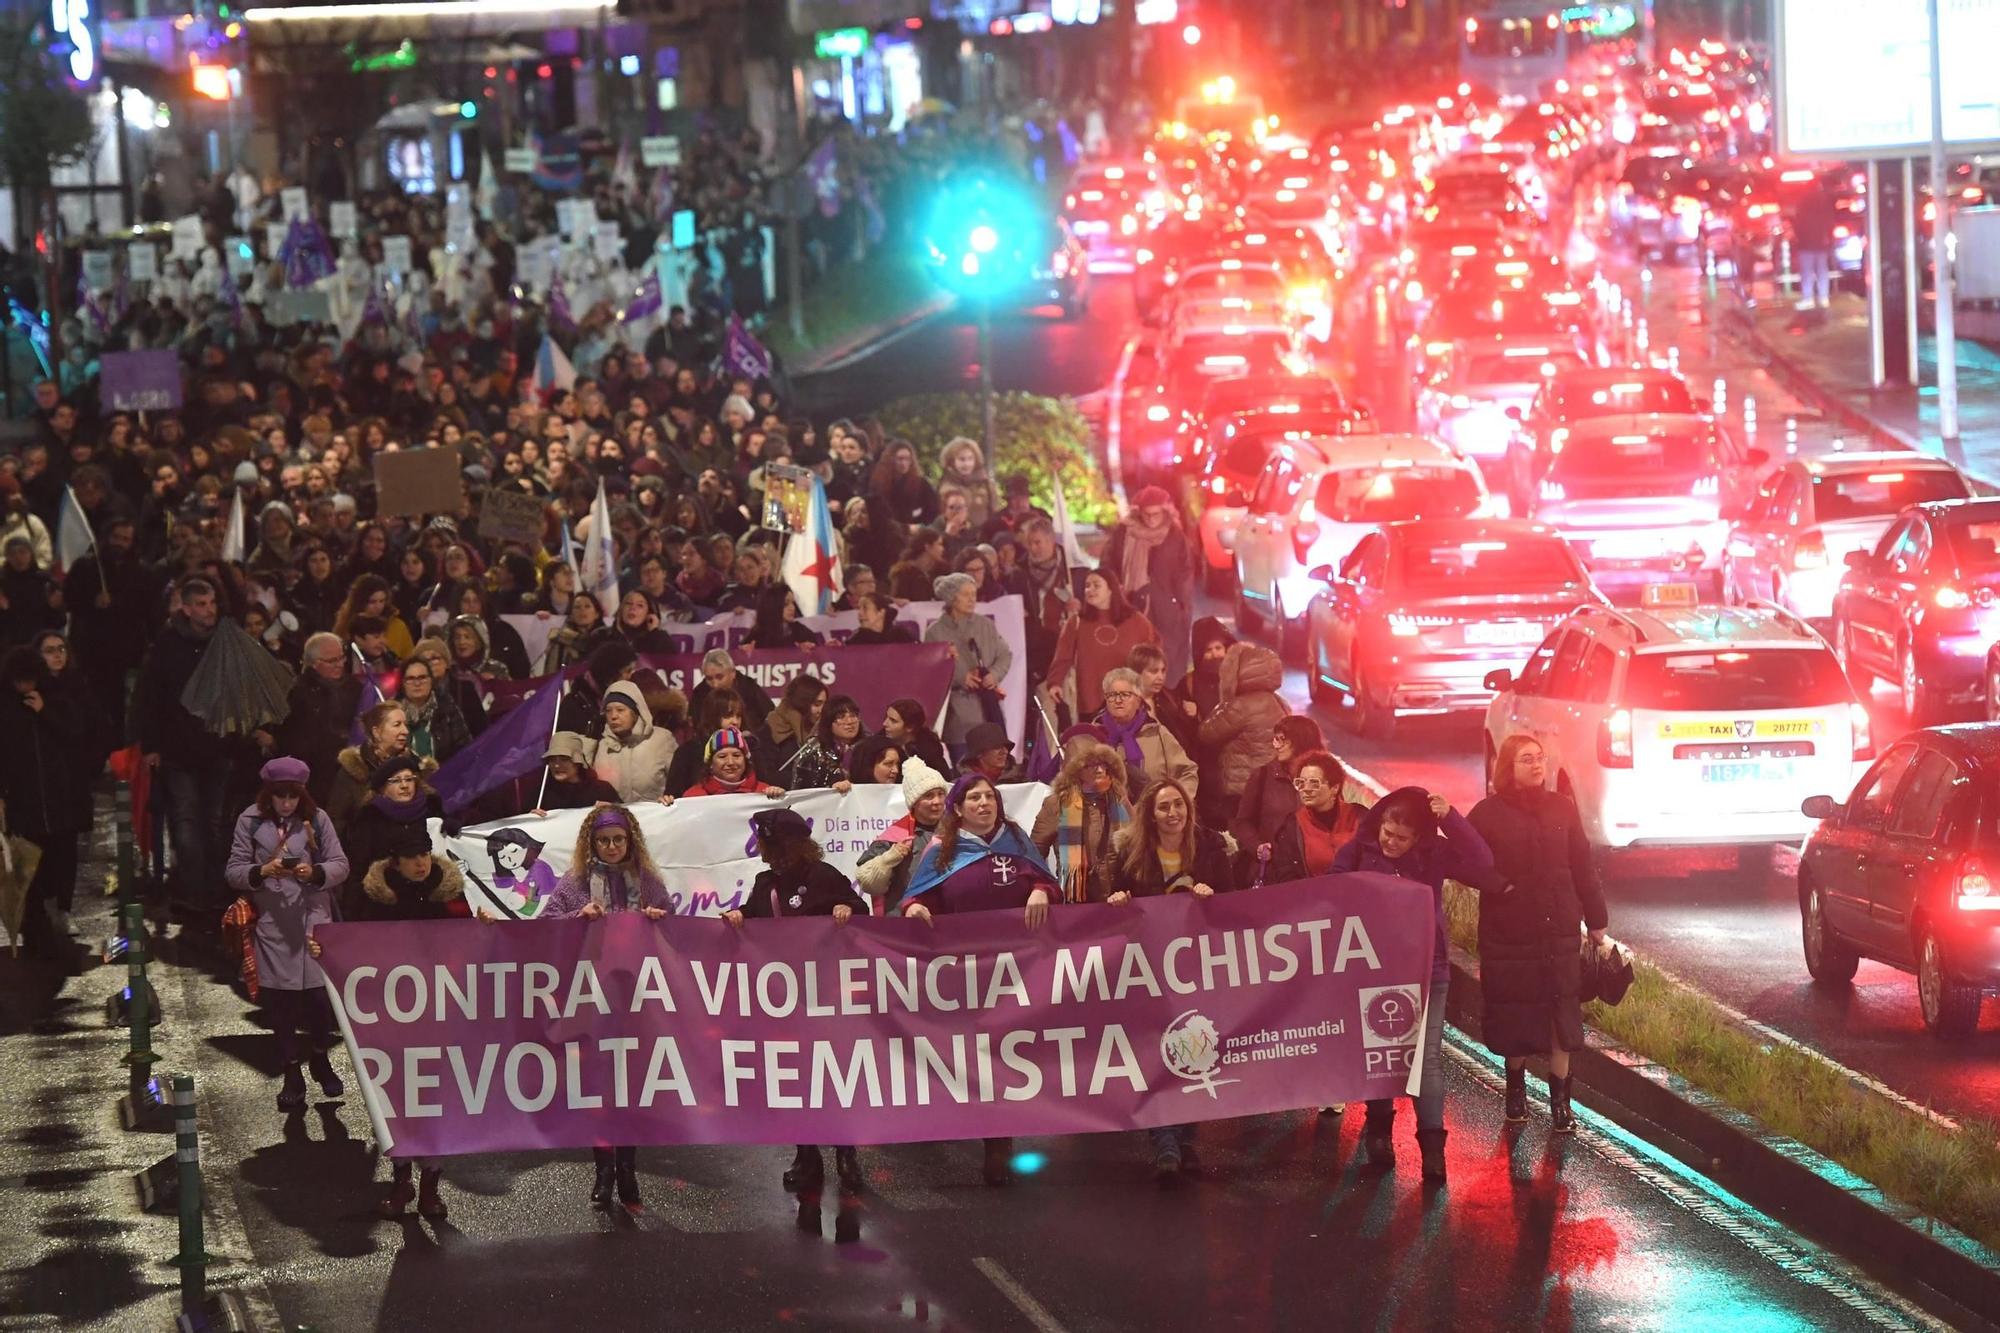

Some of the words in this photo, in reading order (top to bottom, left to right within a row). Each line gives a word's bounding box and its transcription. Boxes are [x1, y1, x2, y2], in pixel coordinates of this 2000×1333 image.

[1709, 726, 1733, 735] TAXI
[1773, 723, 1808, 733] 287777
[825, 816, 849, 832] Día
[826, 838, 844, 853] da
[344, 960, 611, 1024] CONTRA
[630, 956, 677, 1013] A
[690, 951, 1031, 1018] VIOLENCIA
[1051, 915, 1382, 1005] MACHISTA
[1226, 1028, 1280, 1048] marcha
[1283, 1019, 1346, 1041] mundial
[1222, 1050, 1248, 1065] das
[1252, 1042, 1318, 1061] mulleres
[358, 1036, 697, 1119] REVOLTA
[721, 1024, 1148, 1110] FEMINISTA
